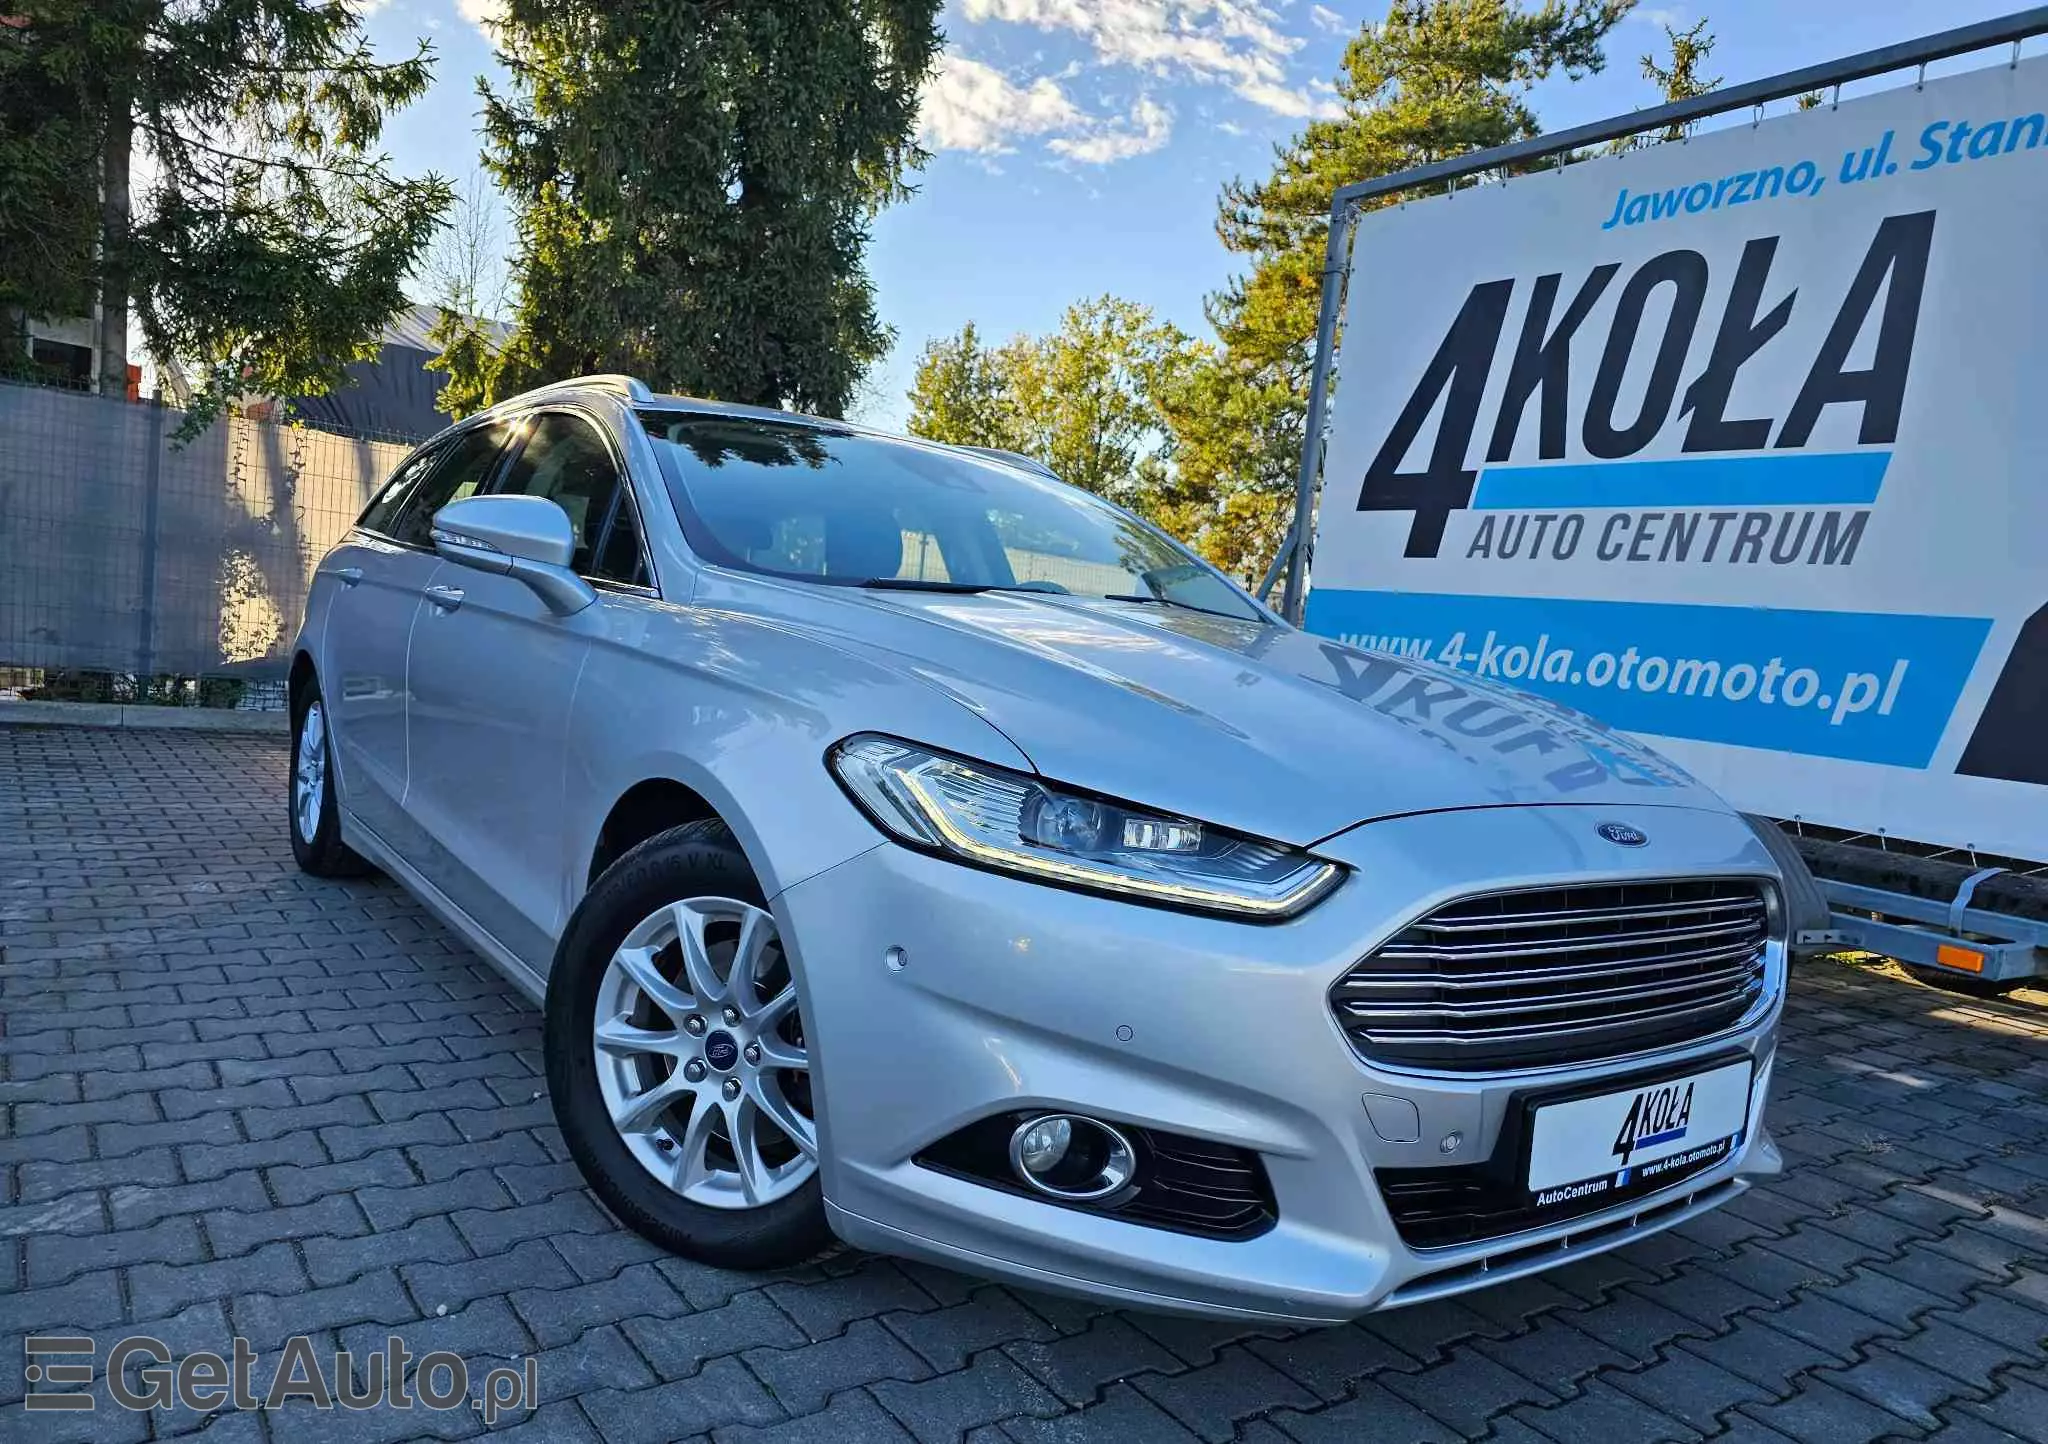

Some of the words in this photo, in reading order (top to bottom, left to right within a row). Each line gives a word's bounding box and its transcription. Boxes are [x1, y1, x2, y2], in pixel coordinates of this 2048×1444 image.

[1602, 158, 1825, 231] Jaworzno,
[1840, 130, 1898, 187] ul.
[1909, 112, 2048, 170] Stan
[1466, 512, 1581, 561] AUTO
[1596, 511, 1872, 567] CENTRUM
[1536, 1179, 1608, 1207] AutoCentrum
[1641, 1142, 1726, 1178] www.4-kola.otomoto.pl
